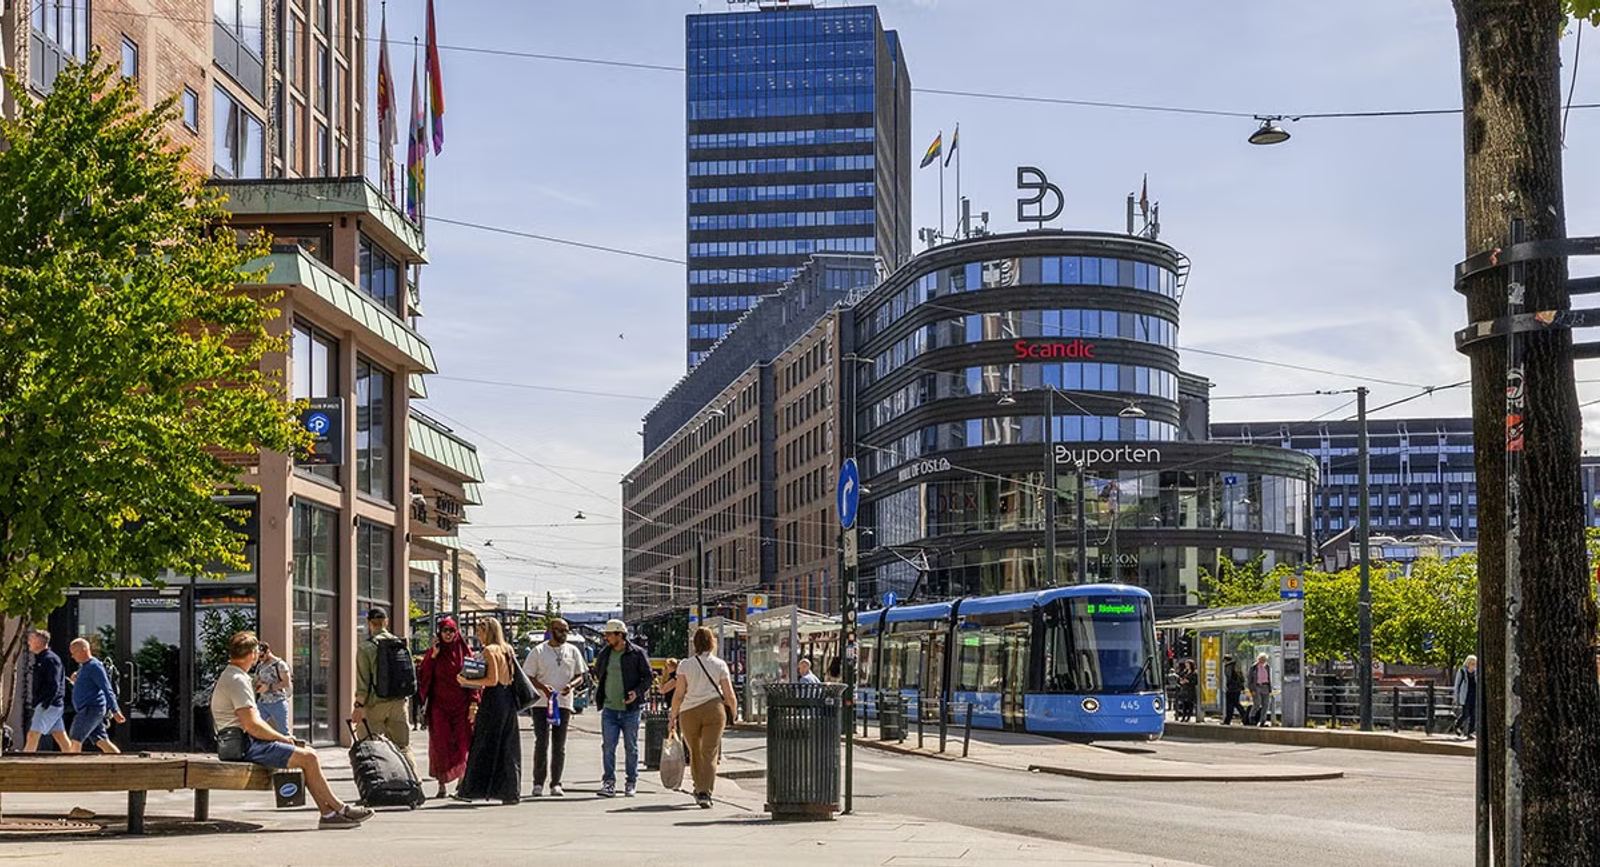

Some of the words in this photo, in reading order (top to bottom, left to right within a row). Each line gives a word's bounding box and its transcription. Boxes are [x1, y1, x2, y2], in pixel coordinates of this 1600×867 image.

[1014, 339, 1095, 358] Scandic
[1055, 445, 1161, 467] Byporten
[1120, 700, 1140, 710] 445
